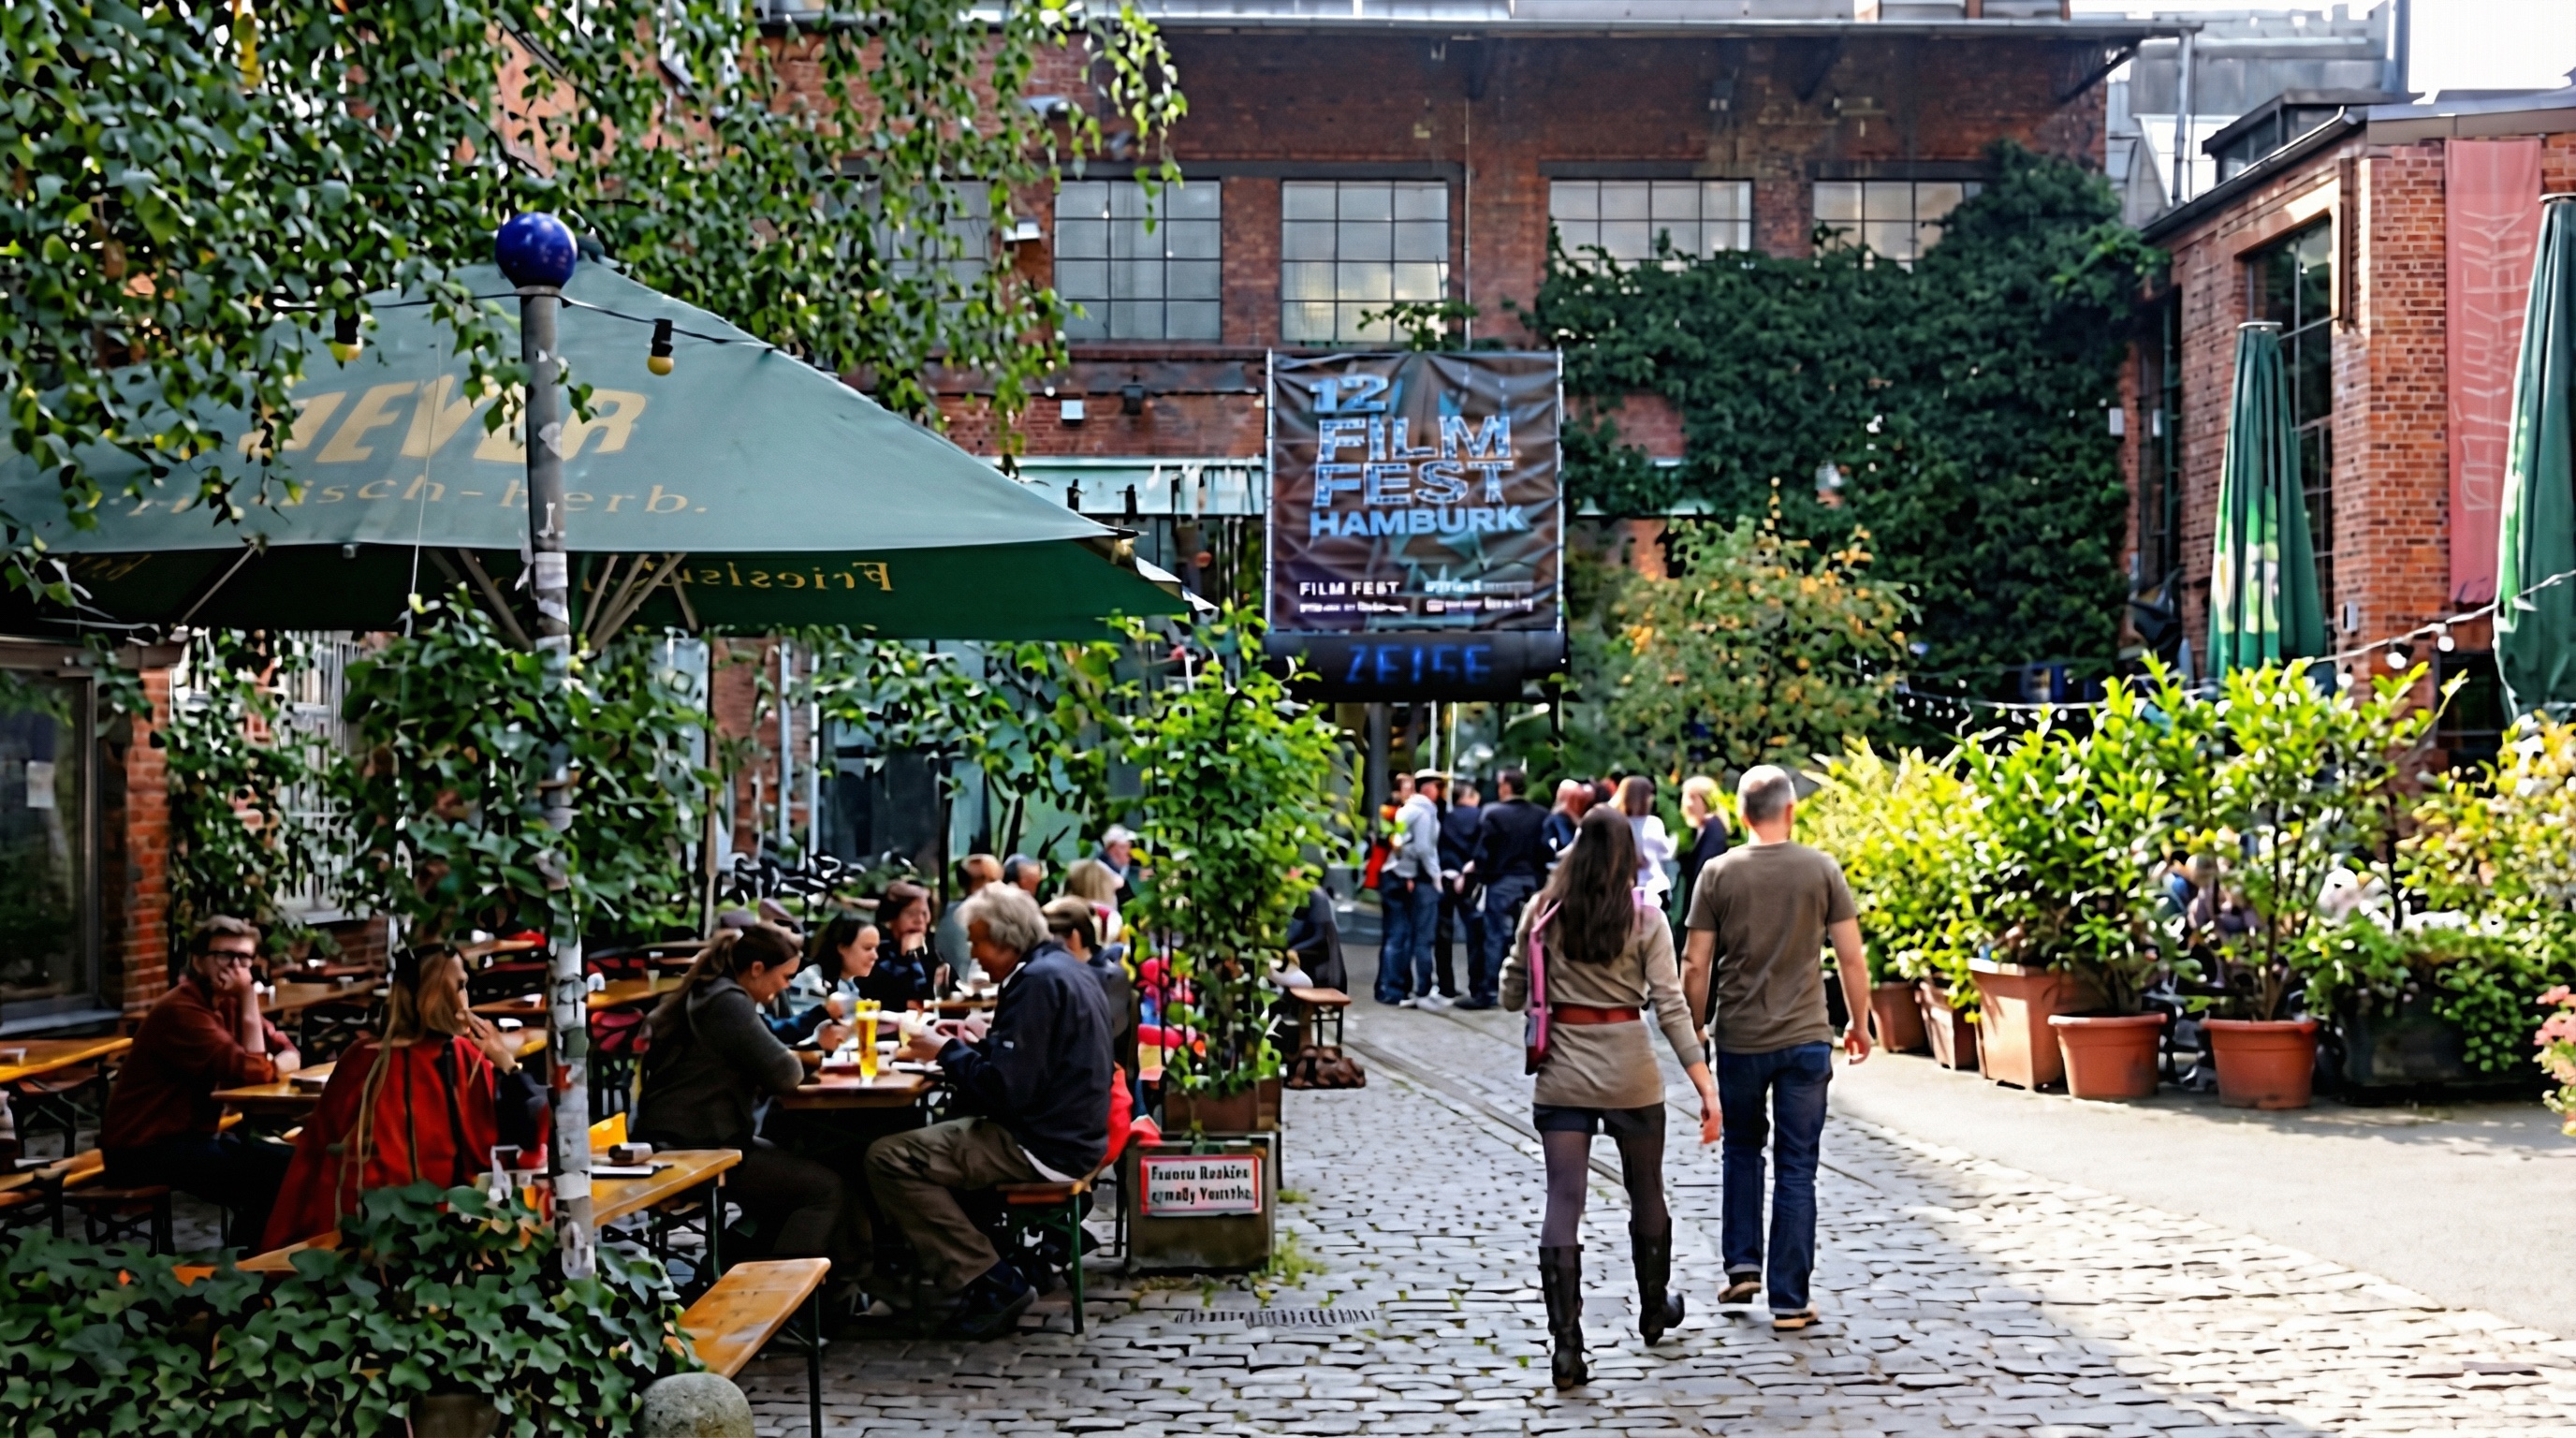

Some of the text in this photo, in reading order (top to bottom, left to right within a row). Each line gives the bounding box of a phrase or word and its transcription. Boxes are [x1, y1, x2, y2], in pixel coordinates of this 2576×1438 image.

[1310, 374, 1389, 414] 12
[1317, 415, 1512, 462] FILM
[1312, 461, 1515, 507] FEST
[1299, 581, 1346, 596] FILM
